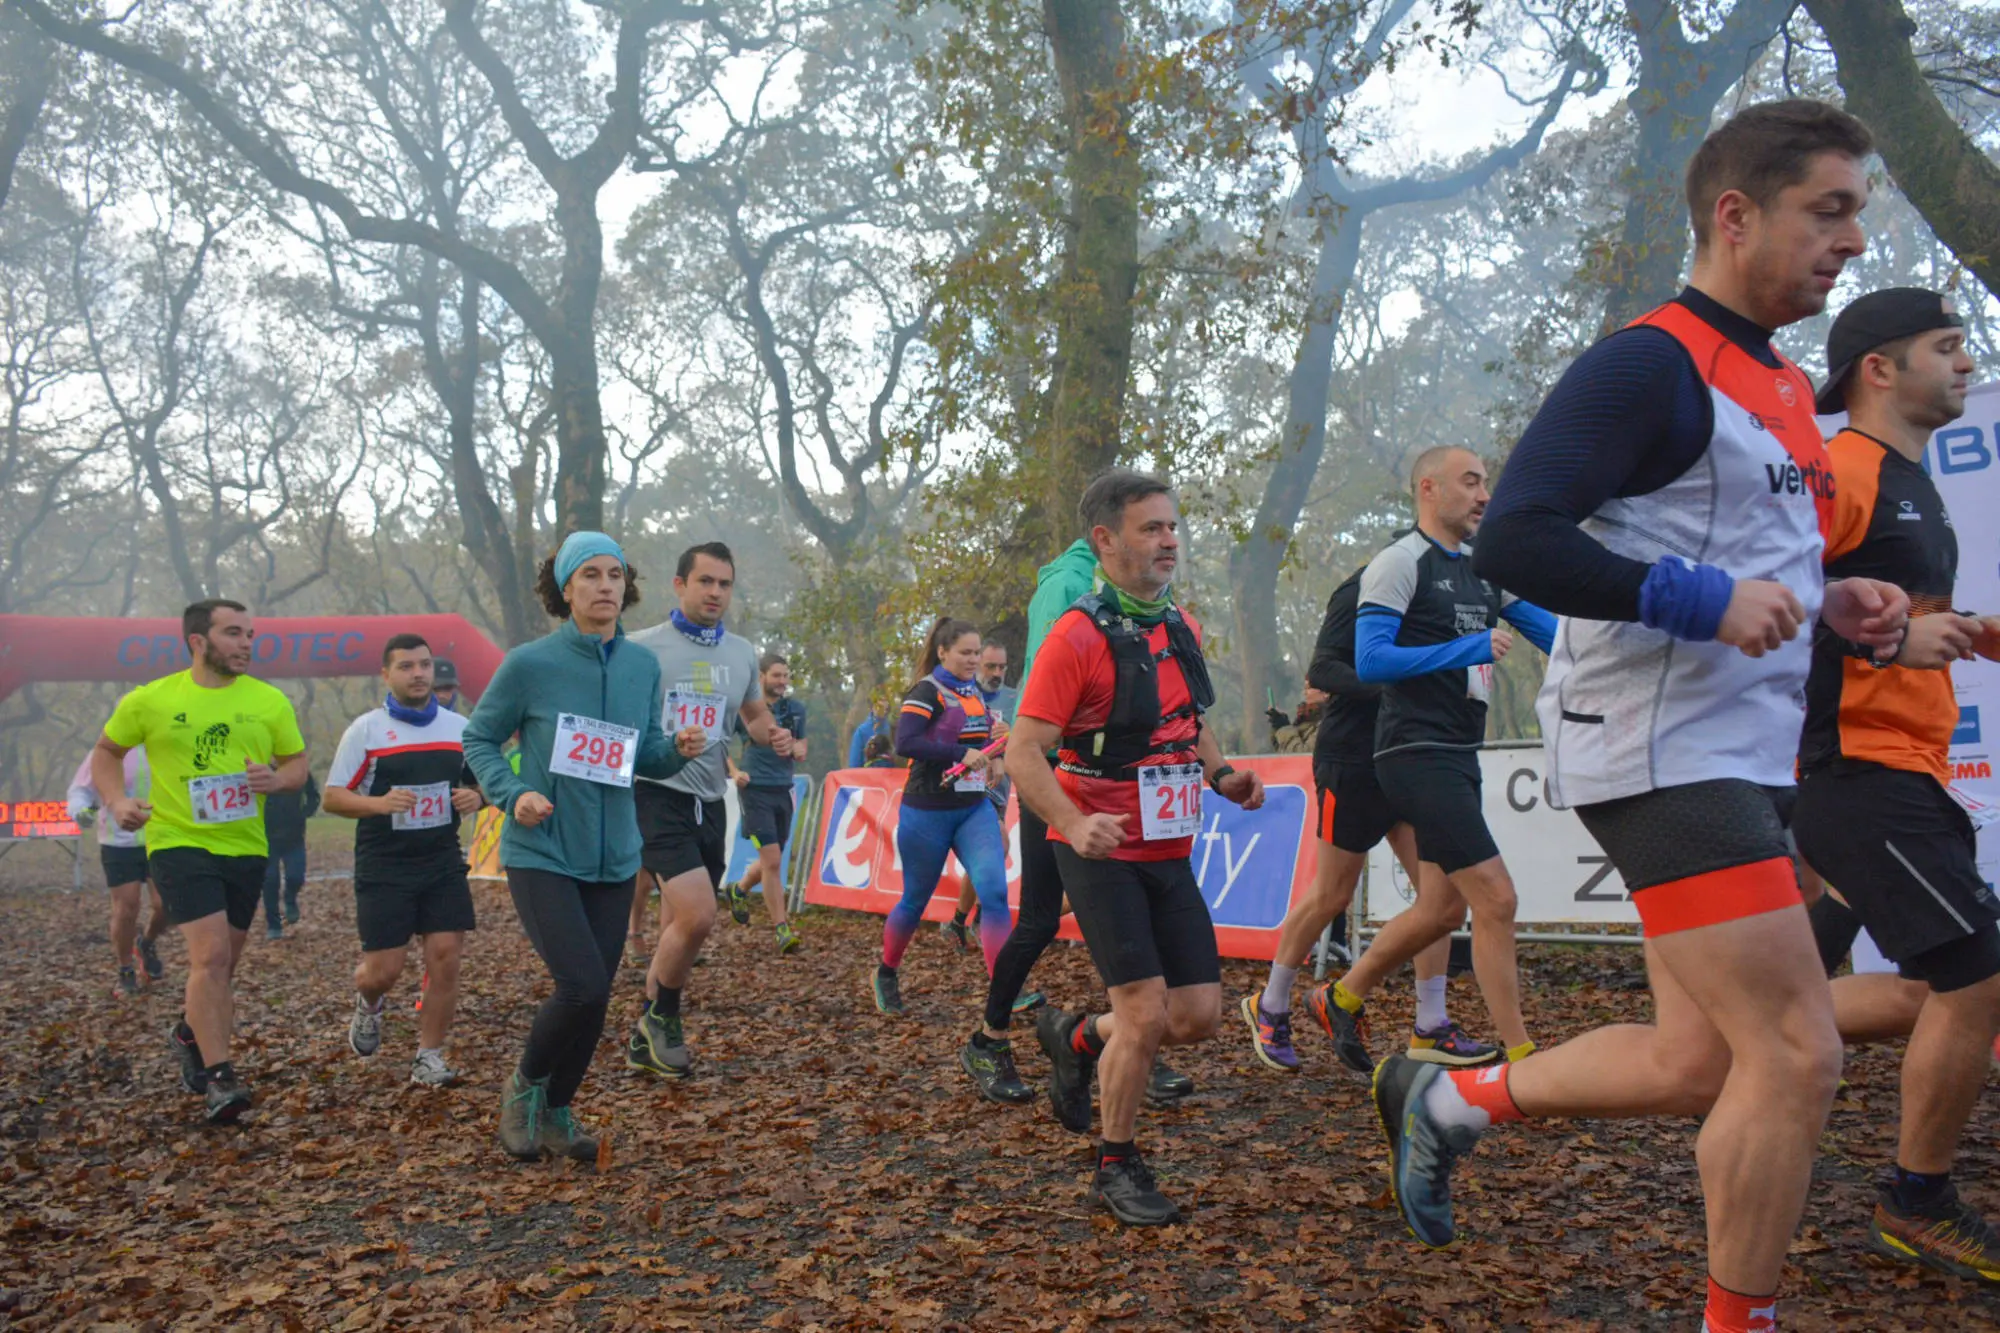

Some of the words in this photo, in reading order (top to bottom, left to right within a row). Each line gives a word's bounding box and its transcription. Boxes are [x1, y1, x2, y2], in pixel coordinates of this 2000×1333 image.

[116, 631, 364, 667] CROTEC
[677, 704, 716, 727] 118
[568, 732, 624, 769] 298
[207, 785, 251, 812] 125
[411, 795, 444, 819] 121
[1157, 783, 1199, 820] 210
